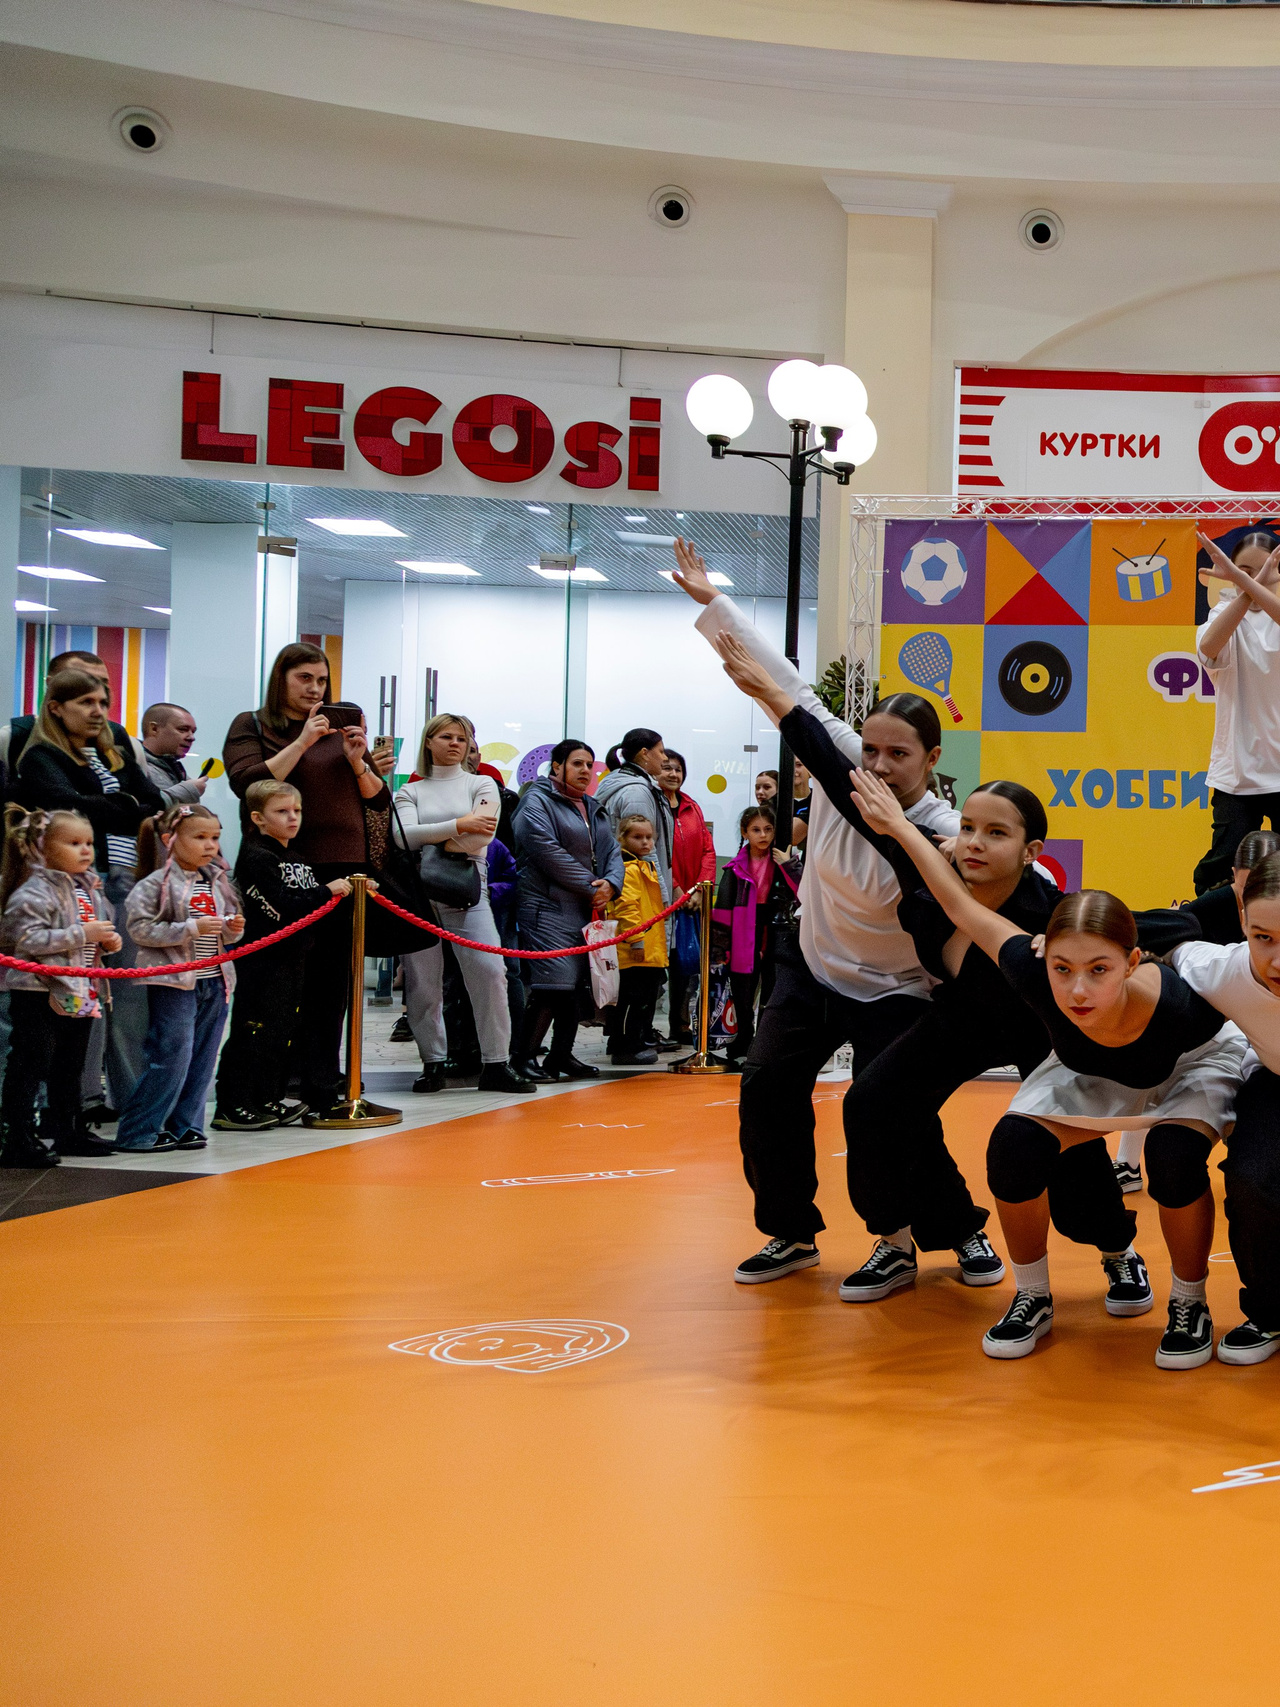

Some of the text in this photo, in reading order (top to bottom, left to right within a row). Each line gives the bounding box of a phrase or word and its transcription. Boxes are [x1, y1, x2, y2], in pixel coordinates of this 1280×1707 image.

[181, 370, 662, 492] LEGOsi
[1039, 431, 1161, 459] КУРТКИ
[1046, 768, 1210, 810] ХОББИ
